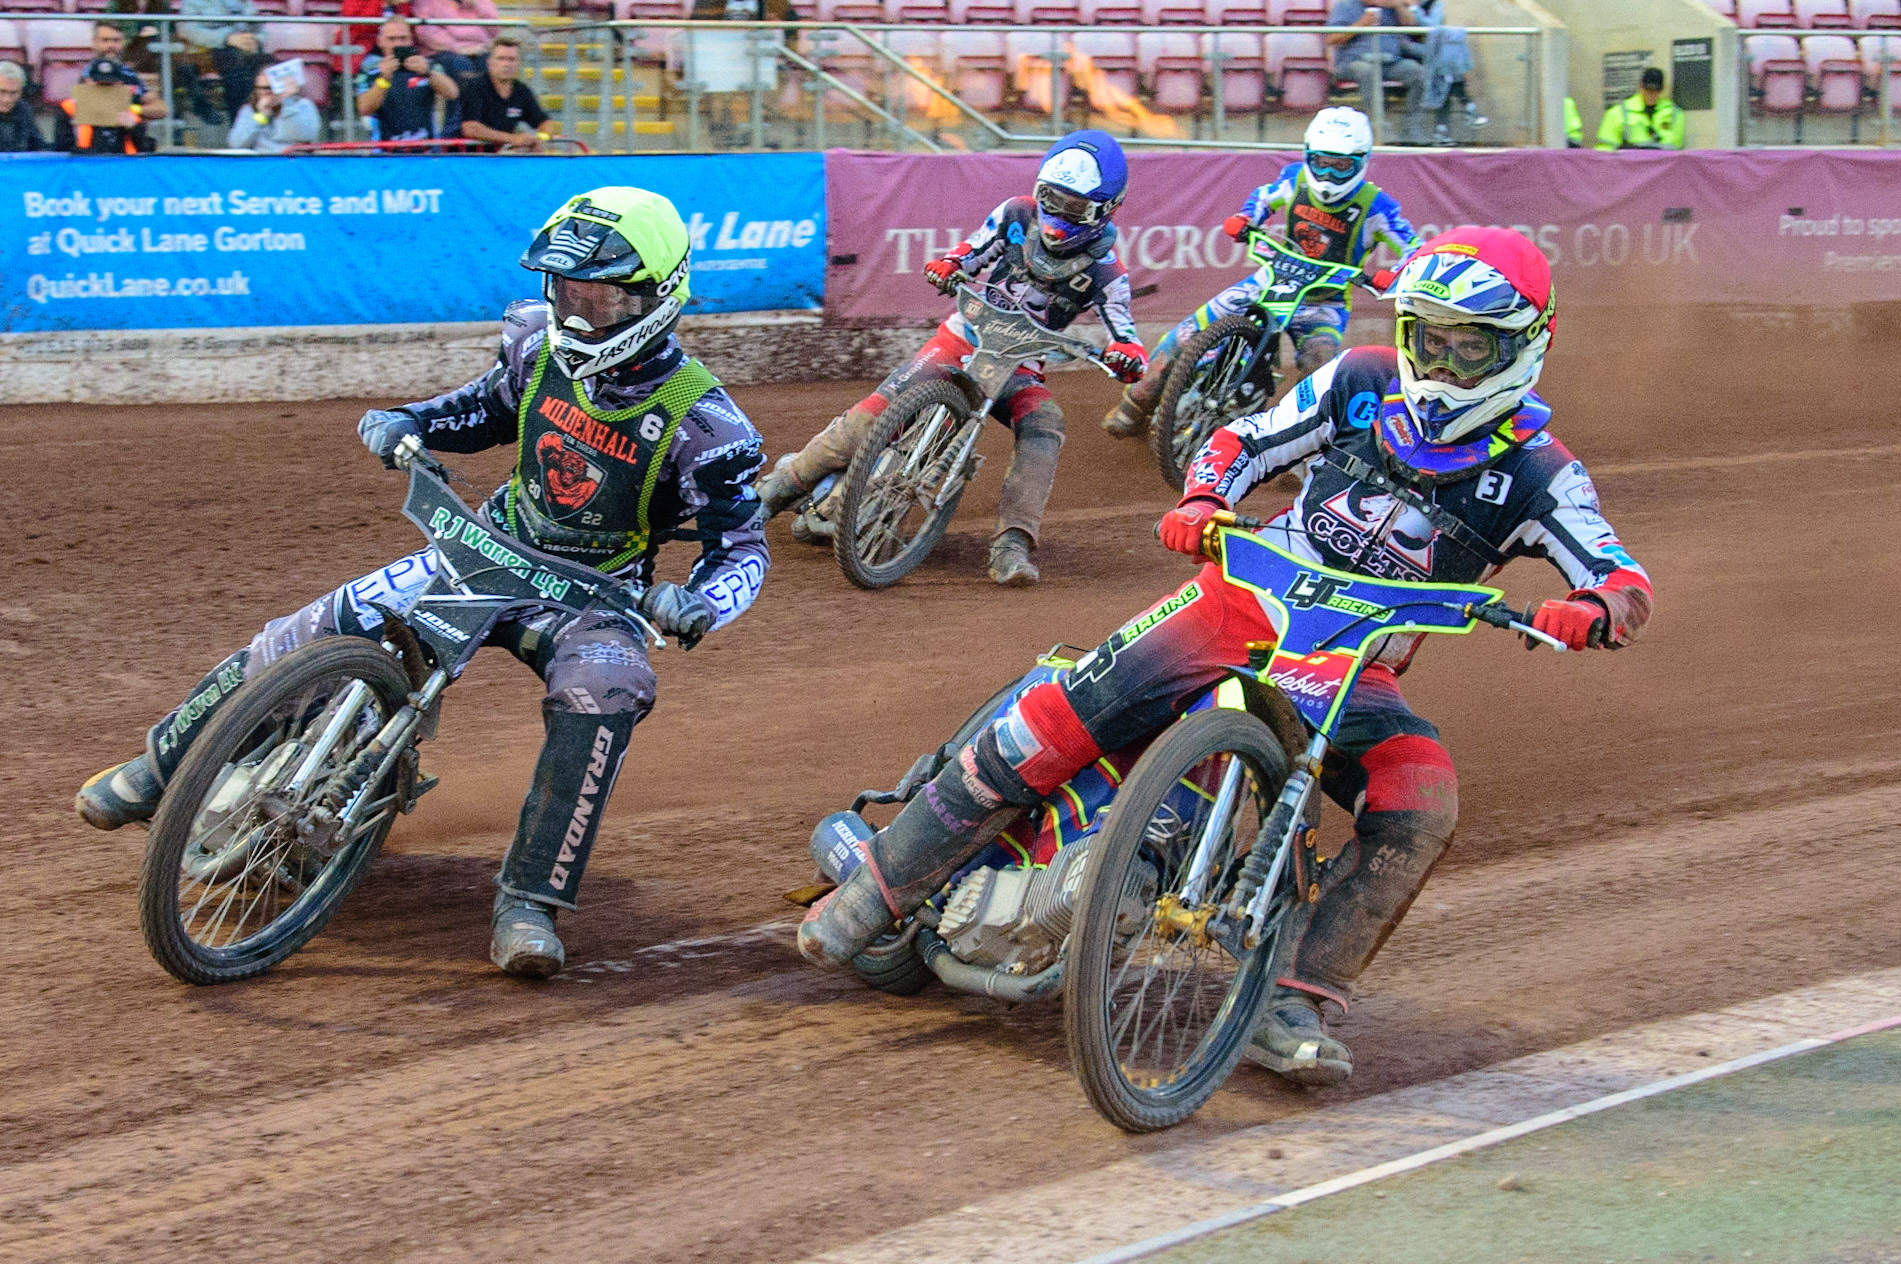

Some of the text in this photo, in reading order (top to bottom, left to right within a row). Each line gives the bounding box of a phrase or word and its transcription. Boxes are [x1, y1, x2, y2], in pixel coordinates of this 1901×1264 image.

[25, 189, 443, 222] Book your next Service and MOT
[28, 226, 306, 257] at Quick Lane Gorton
[714, 211, 817, 250] Lane
[27, 271, 250, 303] QuickLane.co.uk
[538, 396, 639, 465] MILDENHALL
[638, 412, 665, 442] 6
[1480, 471, 1505, 501] 3
[580, 511, 604, 526] 22
[461, 521, 533, 580] Warren
[529, 566, 572, 602] Ltd
[542, 543, 616, 555] RECOVERY
[1122, 582, 1201, 645] RACING
[548, 724, 615, 892] GRANDAD
